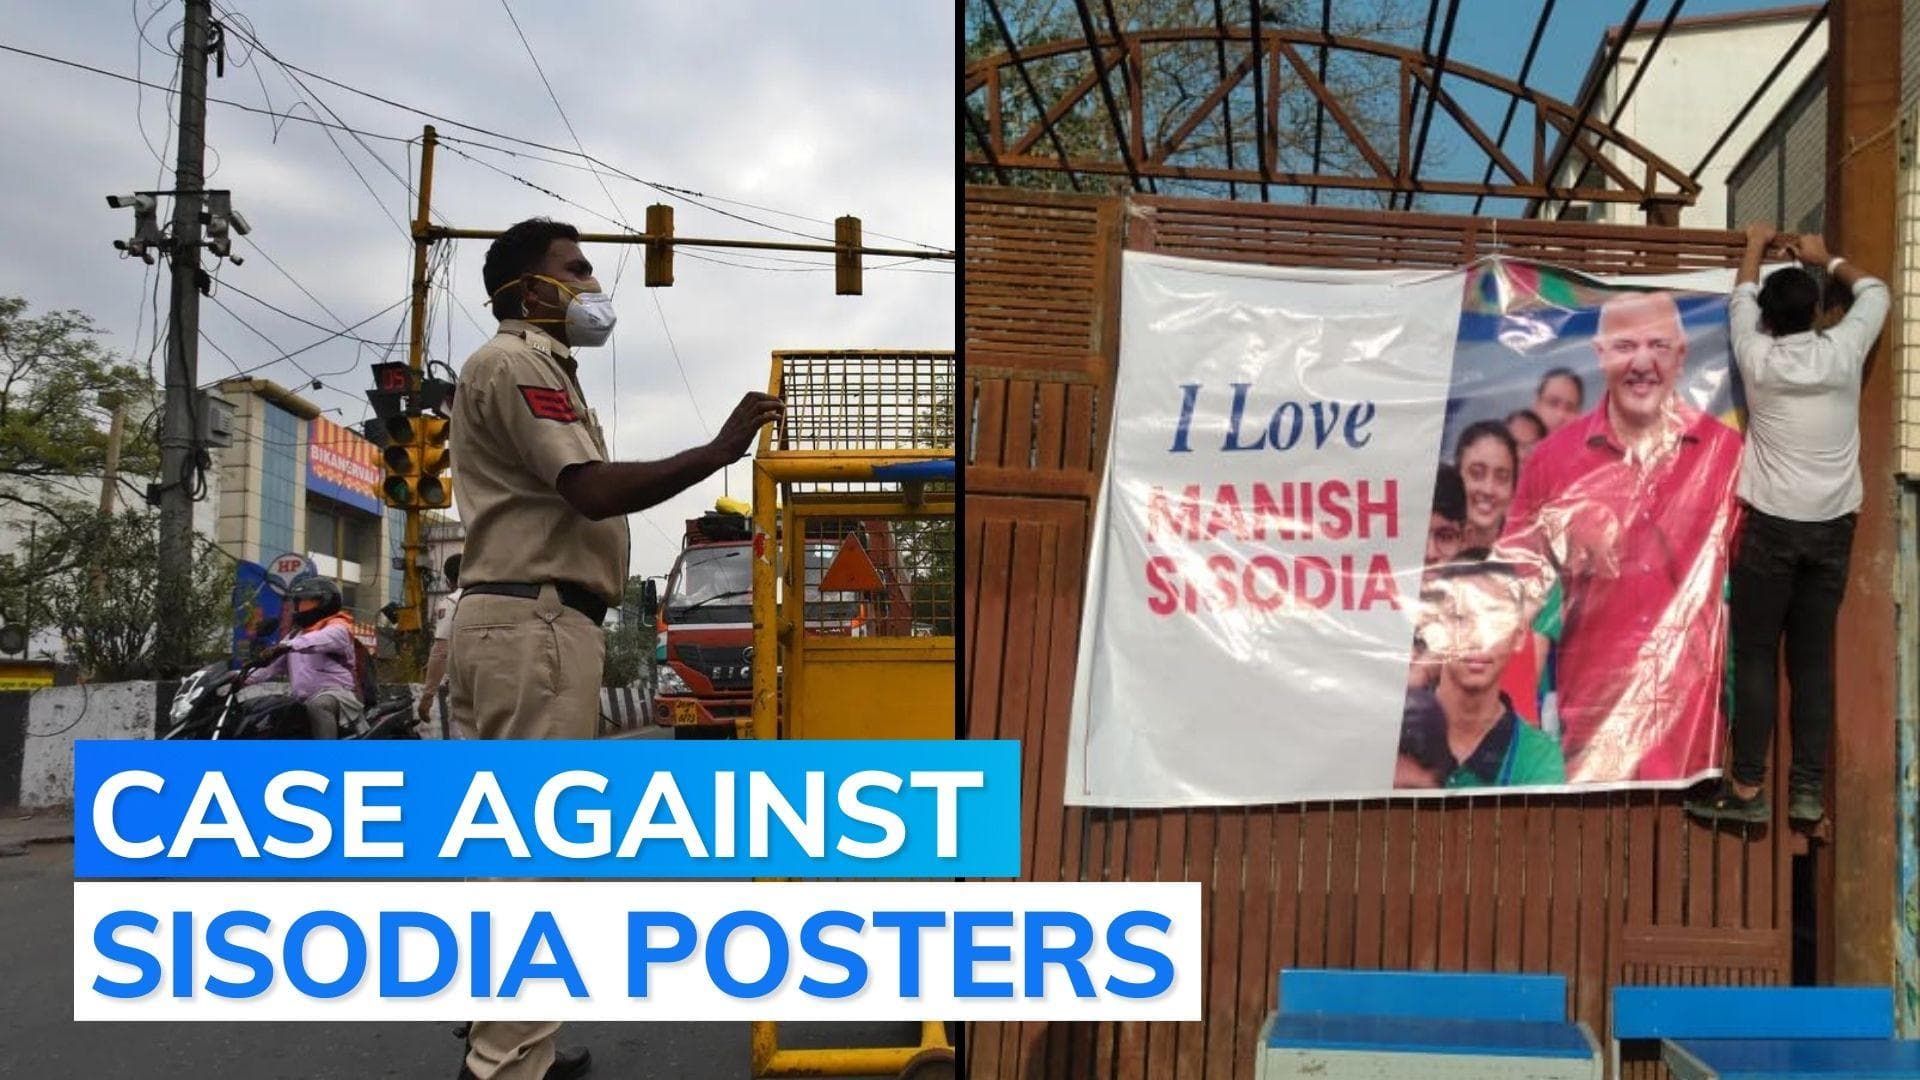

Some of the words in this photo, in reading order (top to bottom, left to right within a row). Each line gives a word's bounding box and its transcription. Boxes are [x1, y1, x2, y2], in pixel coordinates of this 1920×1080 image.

[1169, 384, 1203, 452] I
[1221, 383, 1376, 452] Love
[1148, 479, 1399, 543] MANISH
[277, 560, 302, 573] HP
[1146, 554, 1402, 616] SISODIA
